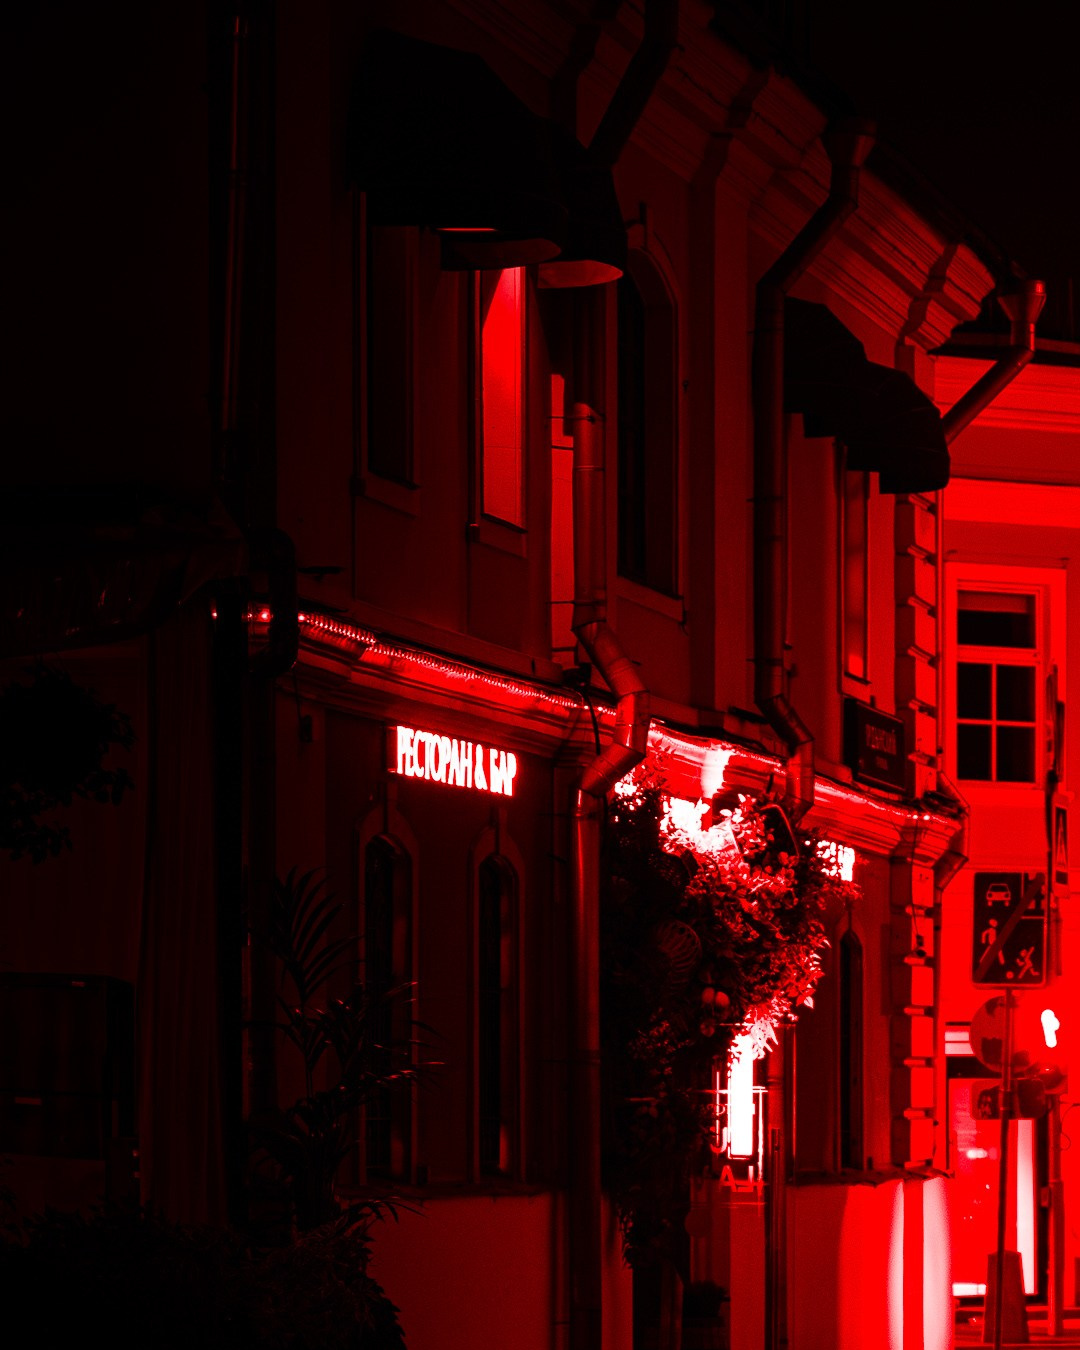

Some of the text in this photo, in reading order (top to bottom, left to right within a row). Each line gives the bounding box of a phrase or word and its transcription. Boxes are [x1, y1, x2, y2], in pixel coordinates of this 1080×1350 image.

[397, 725, 517, 796] РЕСТОРАН & БАР
